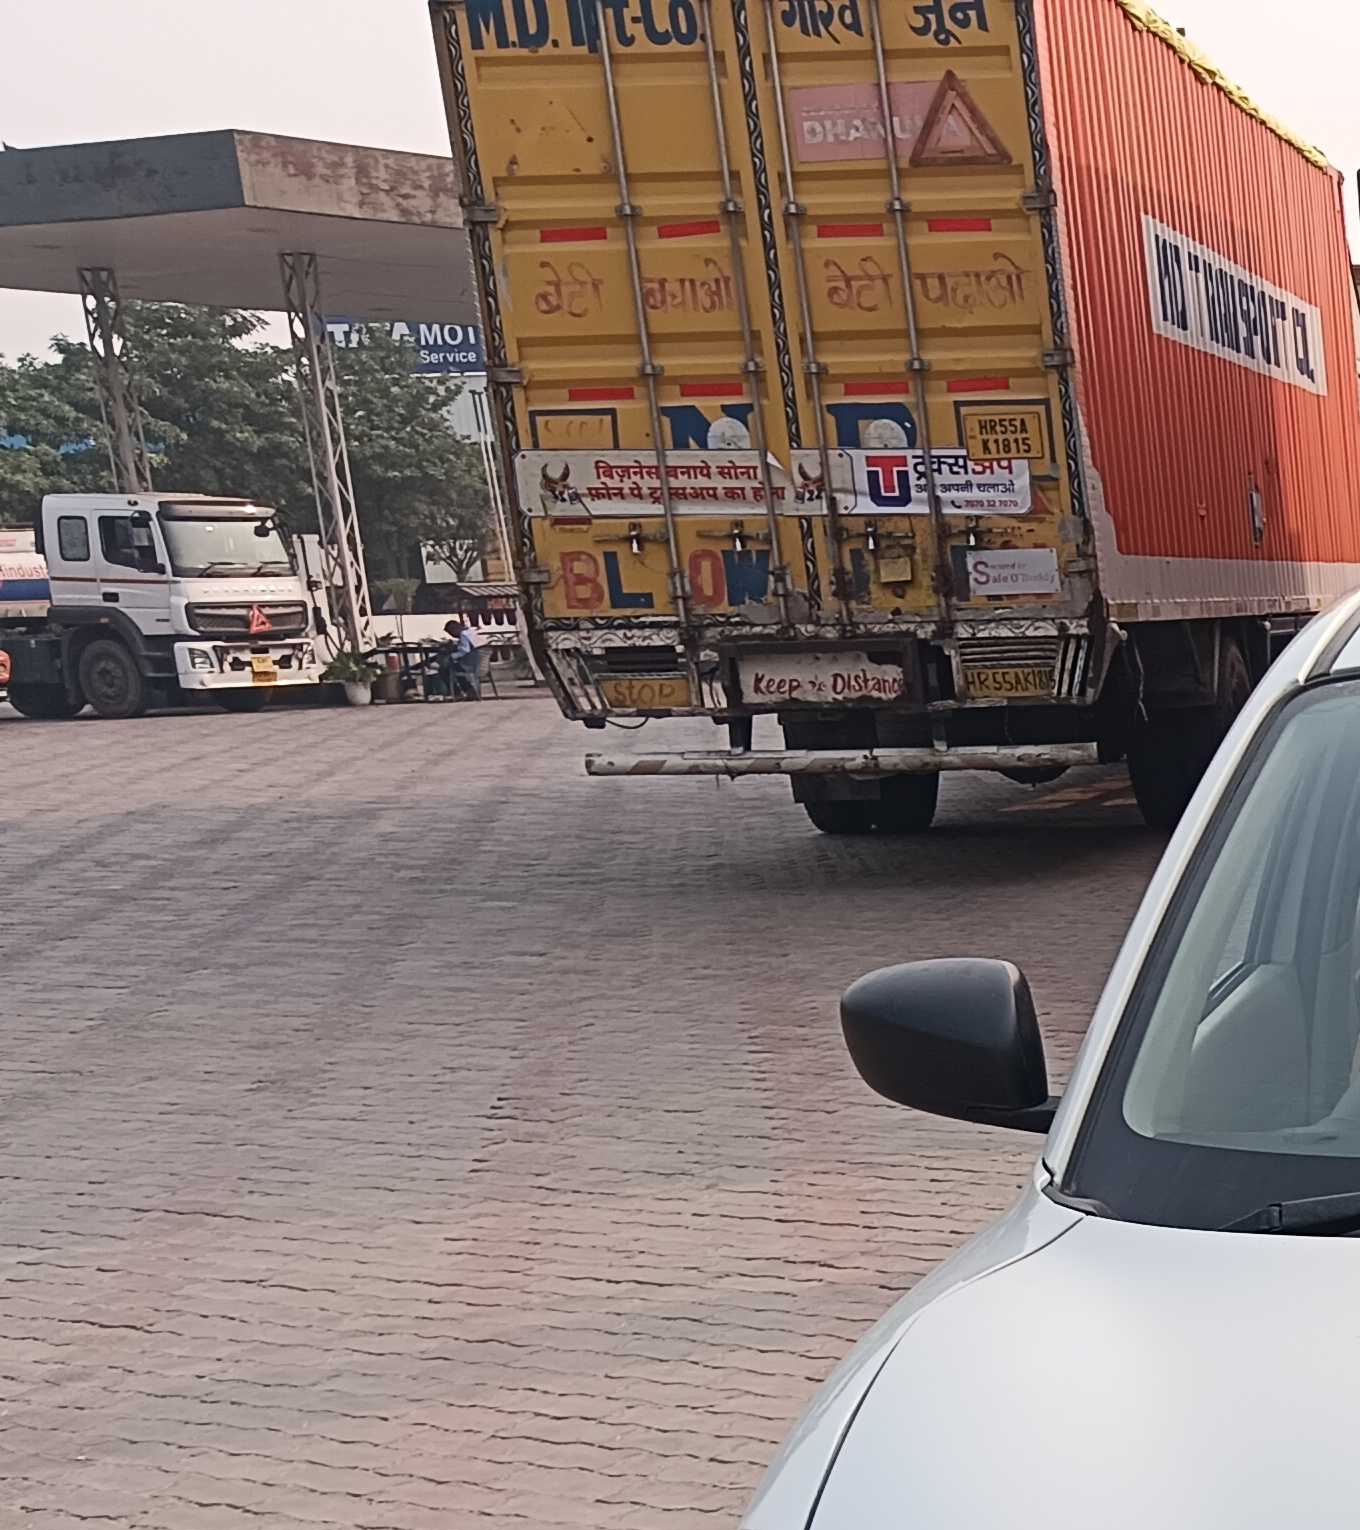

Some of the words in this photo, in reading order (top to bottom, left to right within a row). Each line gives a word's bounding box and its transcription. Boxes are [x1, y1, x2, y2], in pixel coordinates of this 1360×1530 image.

[420, 350, 477, 363] Service
[978, 417, 1028, 436] HR55A
[981, 436, 1032, 455] K1815
[716, 461, 758, 480] सोना
[723, 487, 747, 501] का
[753, 672, 801, 697] Keep
